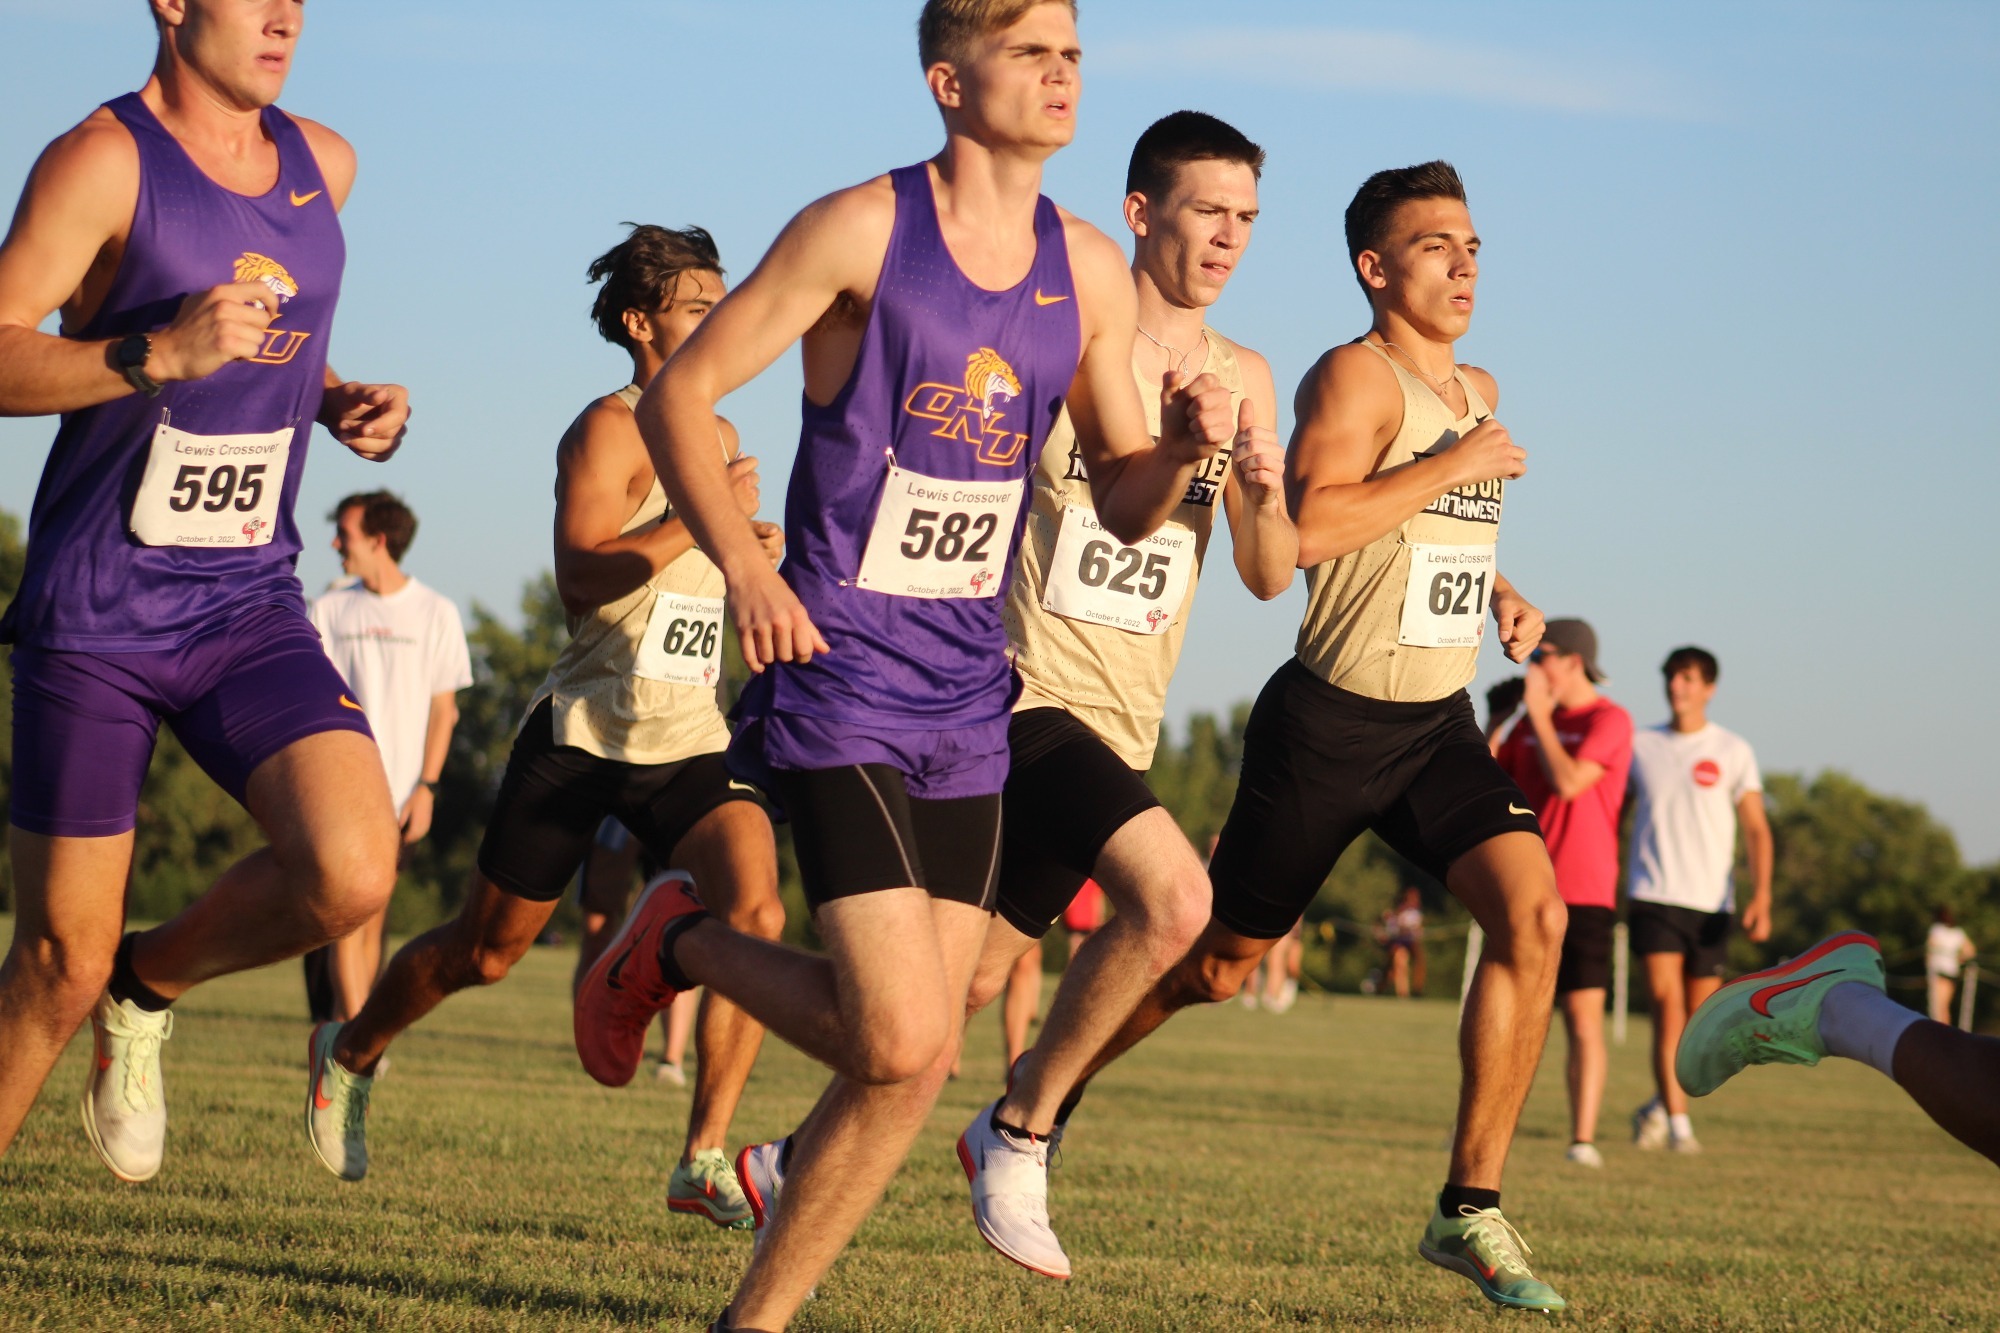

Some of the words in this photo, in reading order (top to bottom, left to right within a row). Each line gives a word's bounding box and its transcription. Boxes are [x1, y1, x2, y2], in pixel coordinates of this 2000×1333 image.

[905, 383, 1029, 466] ONU
[174, 440, 215, 456] Lewis
[219, 442, 280, 456] Crossover
[169, 463, 268, 513] 595
[906, 481, 949, 502] Lewis
[952, 490, 1012, 503] Crossover
[176, 535, 207, 543] October
[217, 535, 236, 543] 2022
[900, 507, 998, 562] 582
[1145, 534, 1183, 549] ssover
[1427, 552, 1457, 564] Lewis
[1458, 553, 1493, 564] Crossover
[1078, 539, 1171, 600] 625
[906, 584, 939, 595] October
[947, 586, 964, 594] 2022
[1428, 571, 1487, 616] 621
[669, 600, 694, 612] Lewis
[1085, 609, 1114, 623] October
[1123, 618, 1141, 628] 2022
[662, 618, 719, 660] 626
[1437, 636, 1457, 644] October
